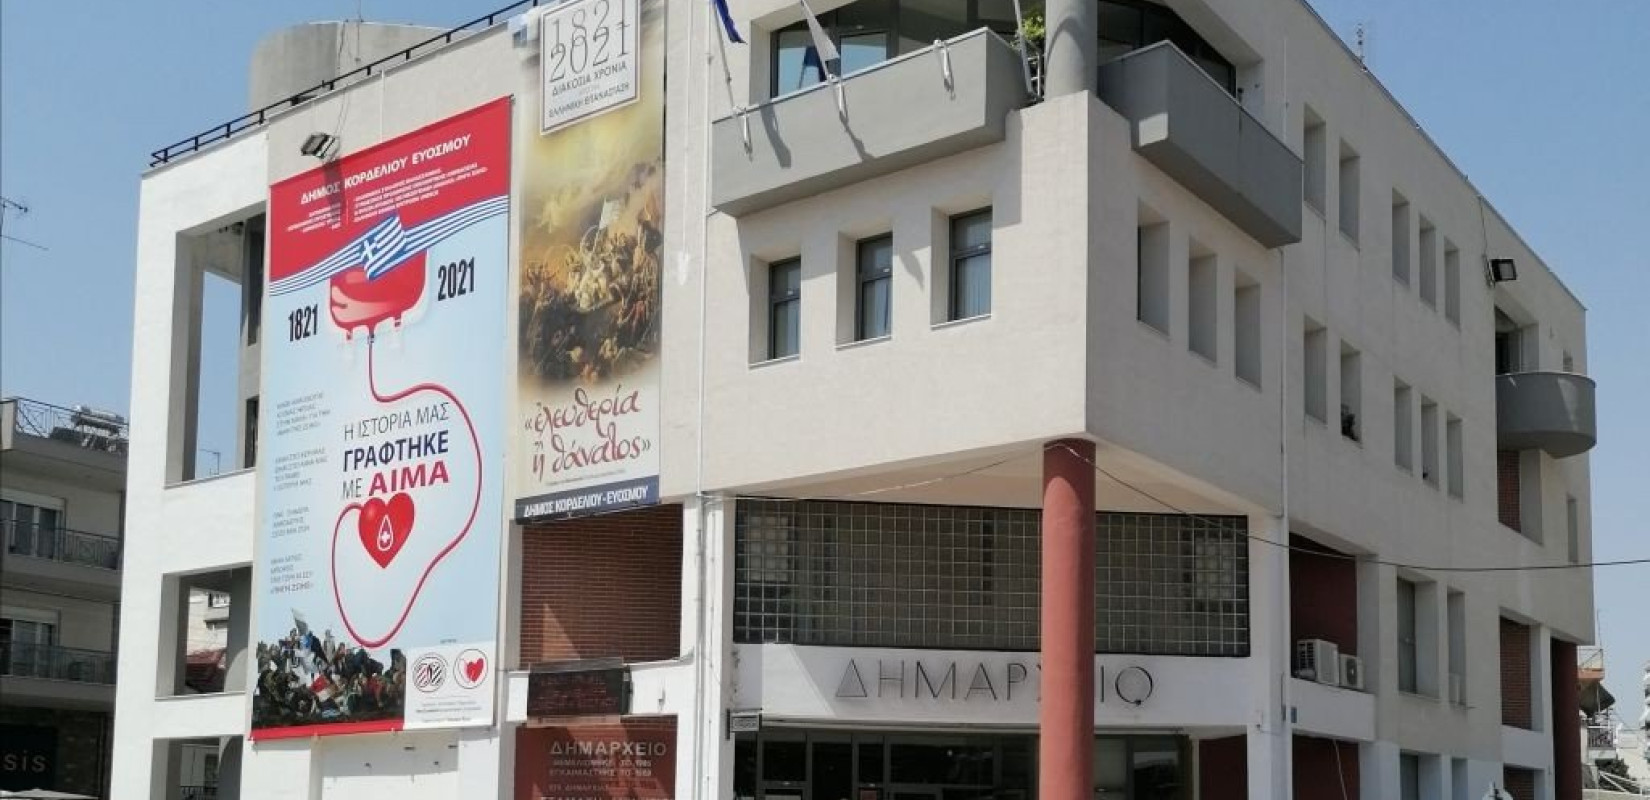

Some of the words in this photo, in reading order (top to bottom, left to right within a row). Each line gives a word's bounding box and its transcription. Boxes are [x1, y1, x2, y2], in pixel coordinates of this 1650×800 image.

[552, 0, 631, 54] 1821
[549, 21, 629, 83] 2021
[552, 75, 592, 96] ΔΙΑΚΟΣΙΑ
[594, 61, 628, 81] ΧΡΟΝΙΑ
[301, 181, 341, 205] ΔΗΜΟΣ
[344, 157, 408, 189] ΚΟΡΔΕΛΙΟΥ
[411, 134, 471, 165] ΕΥΟΣΜΟΥ
[438, 257, 475, 301] 2021
[288, 304, 318, 342] 1821
[344, 423, 354, 440] Η
[358, 411, 412, 438] ΙΣΤΟΡΙΑ
[416, 402, 450, 423] ΜΑΣ
[344, 430, 449, 472] ΓΡΑΦΤΗΚΕ
[341, 478, 362, 499] ΜΕ
[368, 461, 449, 496] ΑΙΜΑ
[834, 657, 1154, 705] ΔΗΜΑΡΙΟ
[550, 741, 667, 757] ΔΗΜΑΡΧΕΙΟ
